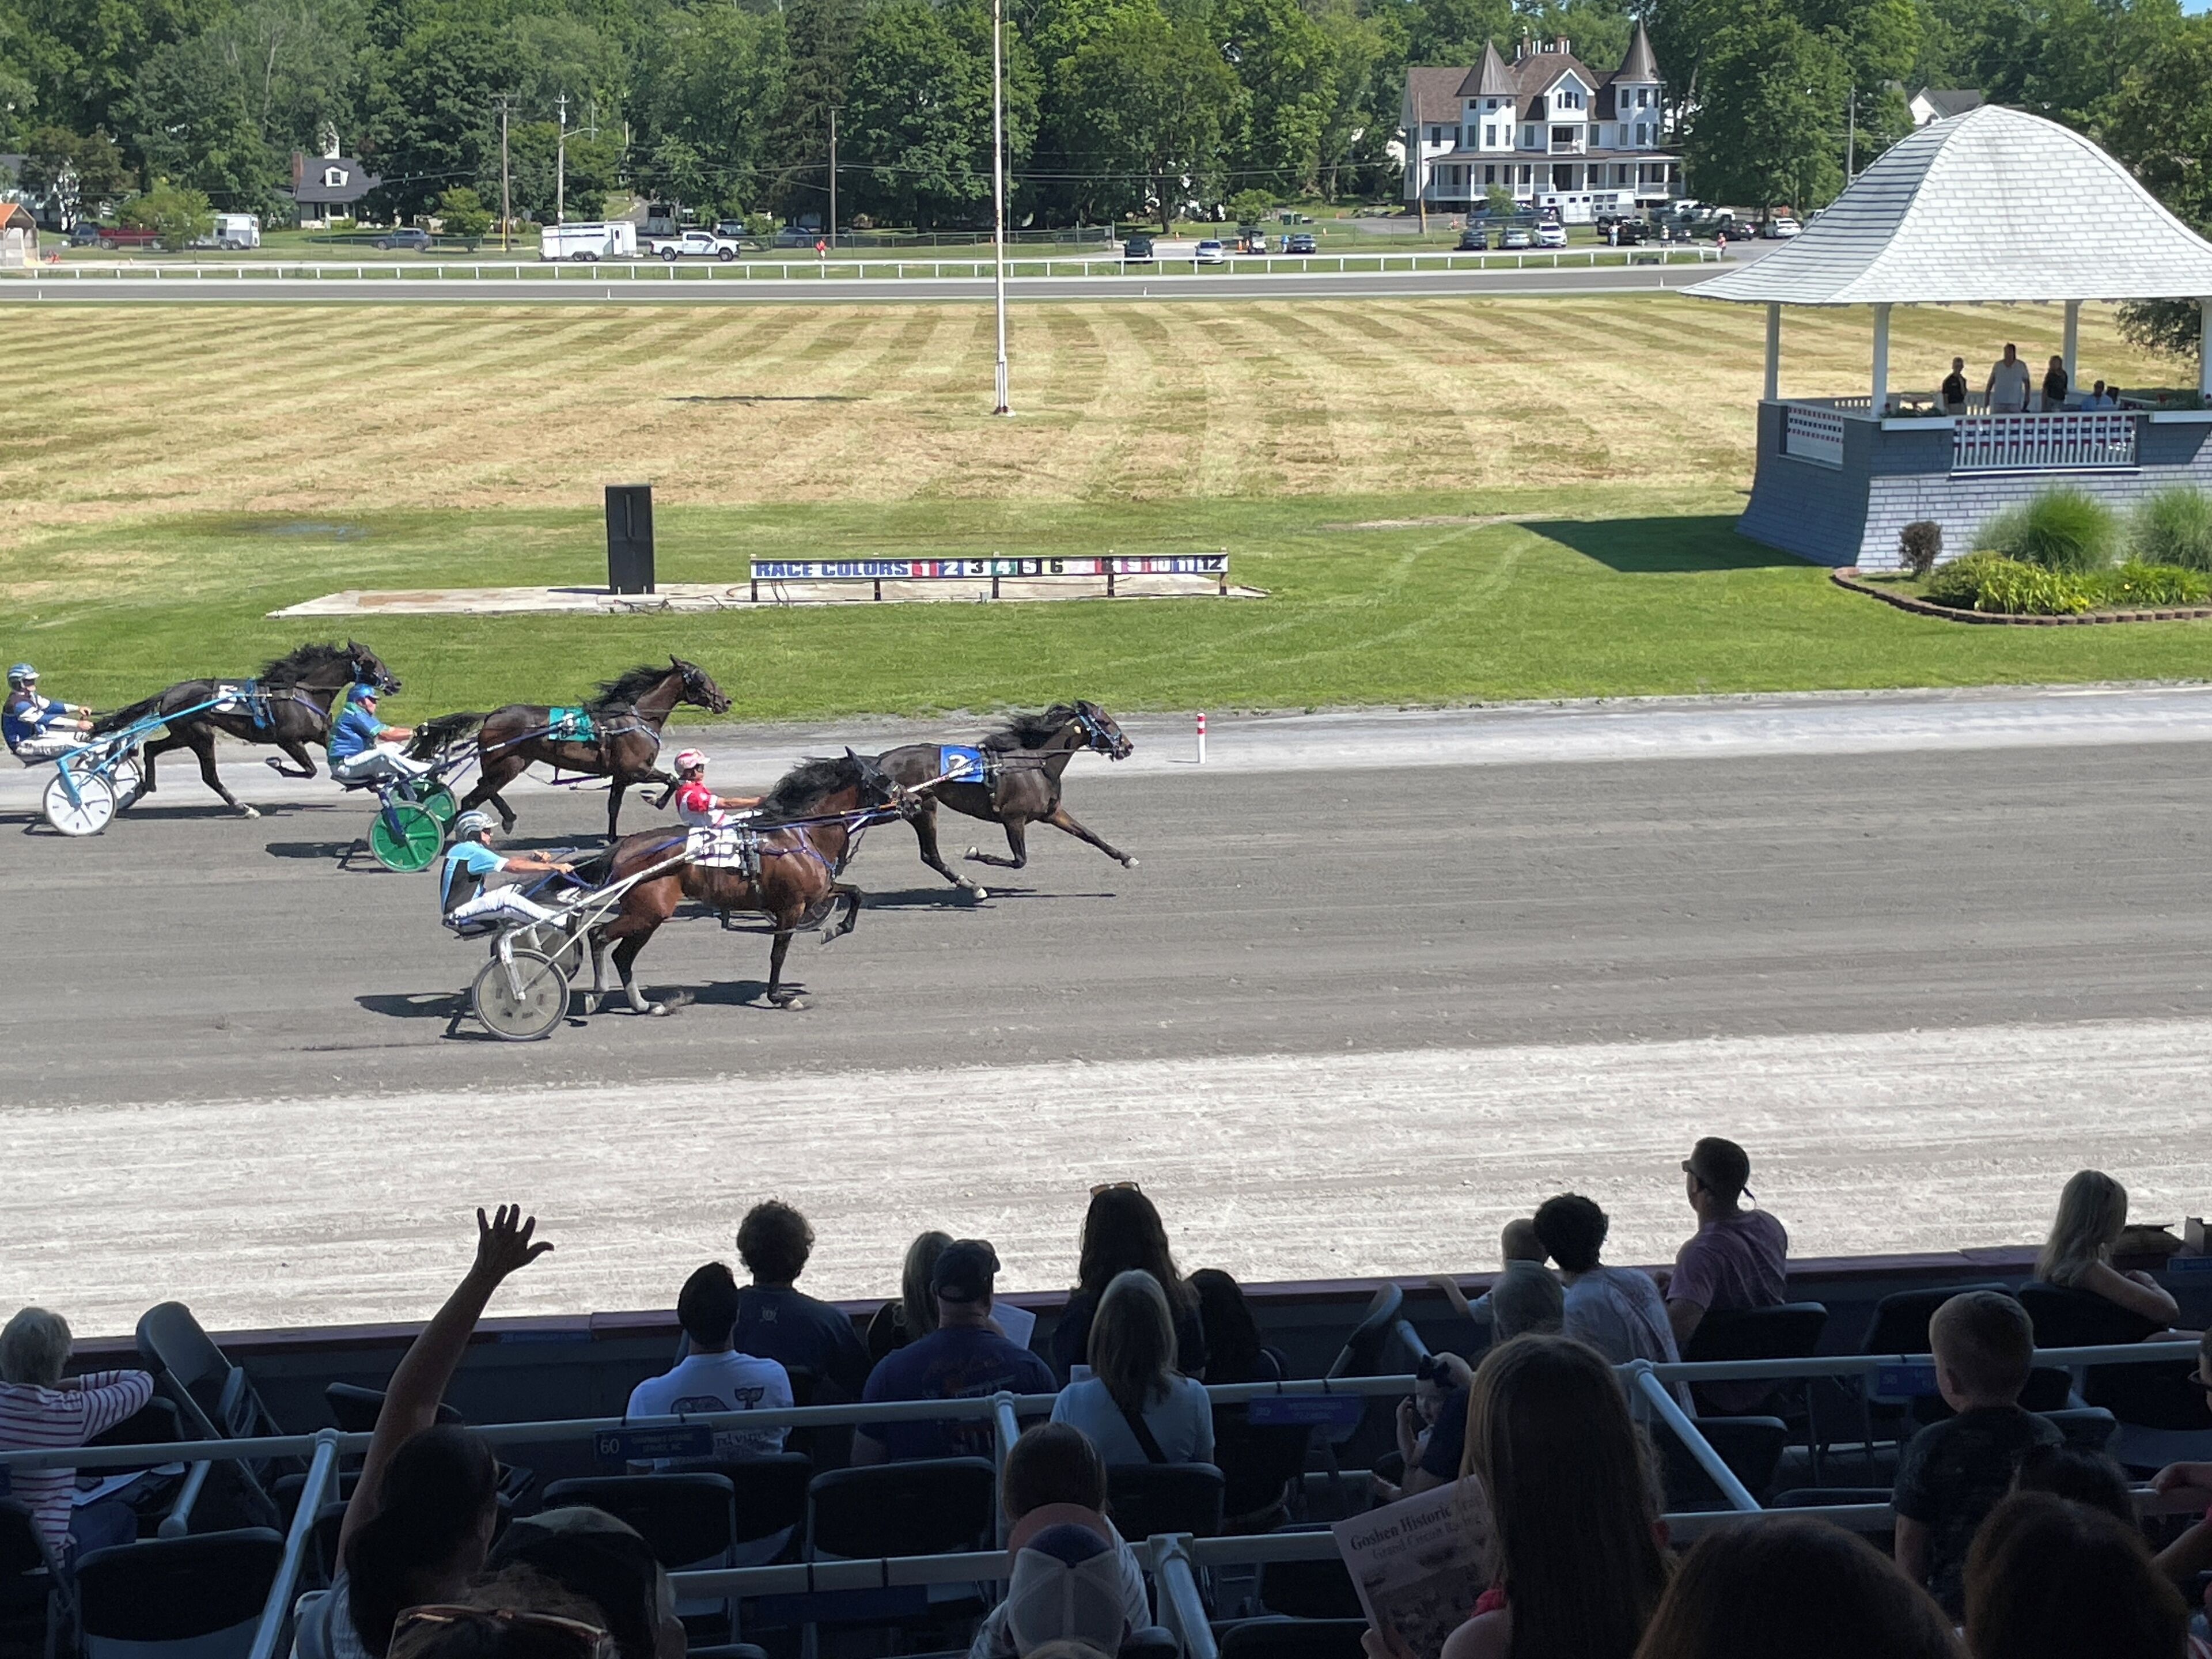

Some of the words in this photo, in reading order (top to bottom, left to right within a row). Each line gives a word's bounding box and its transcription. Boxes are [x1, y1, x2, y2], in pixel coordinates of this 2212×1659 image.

[756, 561, 813, 576] RACE
[821, 561, 909, 575] COLORS
[921, 561, 930, 576] 1
[944, 560, 959, 575] 2
[971, 559, 984, 574] 3
[996, 559, 1012, 574] 4
[1022, 559, 1037, 574] 5
[1050, 558, 1064, 574] 6
[1150, 558, 1170, 572] 10
[1202, 557, 1222, 570] 12
[946, 754, 974, 777] 2
[600, 1438, 620, 1455] 60
[1350, 1527, 1400, 1550] Goshen
[1400, 1506, 1452, 1533] Historic
